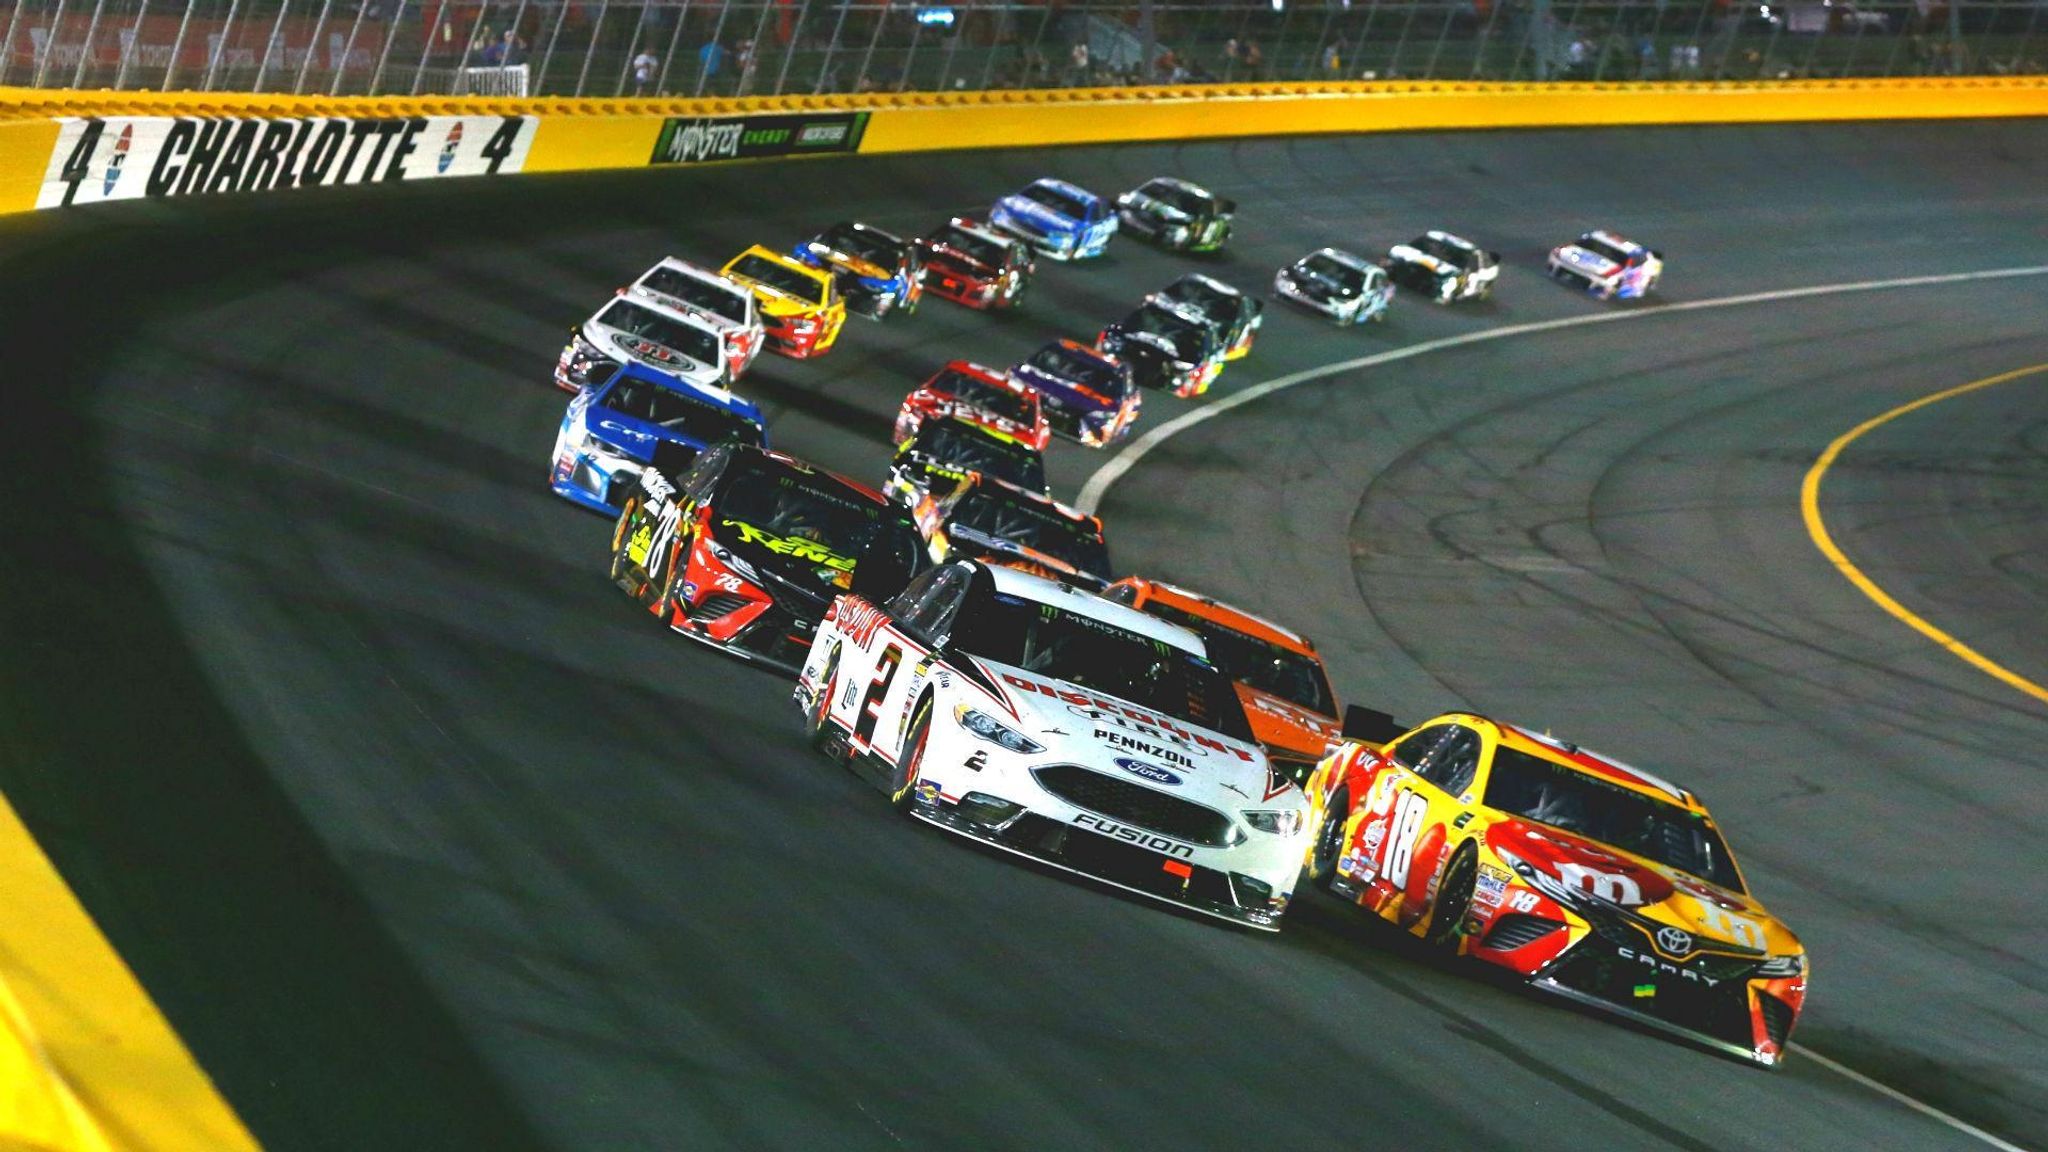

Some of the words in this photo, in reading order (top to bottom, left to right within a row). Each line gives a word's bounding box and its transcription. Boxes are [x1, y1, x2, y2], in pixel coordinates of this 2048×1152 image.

[60, 118, 105, 206] 4
[145, 118, 428, 197] CHARLOTTE
[481, 115, 524, 174] 4
[668, 118, 745, 162] MONSTER
[641, 497, 682, 579] 78
[713, 572, 746, 594] 78
[1065, 613, 1148, 646] MONSTER
[852, 642, 903, 753] 2
[964, 749, 988, 773] 2
[1093, 729, 1198, 769] PENNZOIL
[1127, 761, 1170, 784] Ford
[1072, 813, 1194, 858] FUSION
[1381, 786, 1429, 892] 18
[1508, 889, 1541, 914] 18
[1618, 947, 1720, 988] CAMRY
